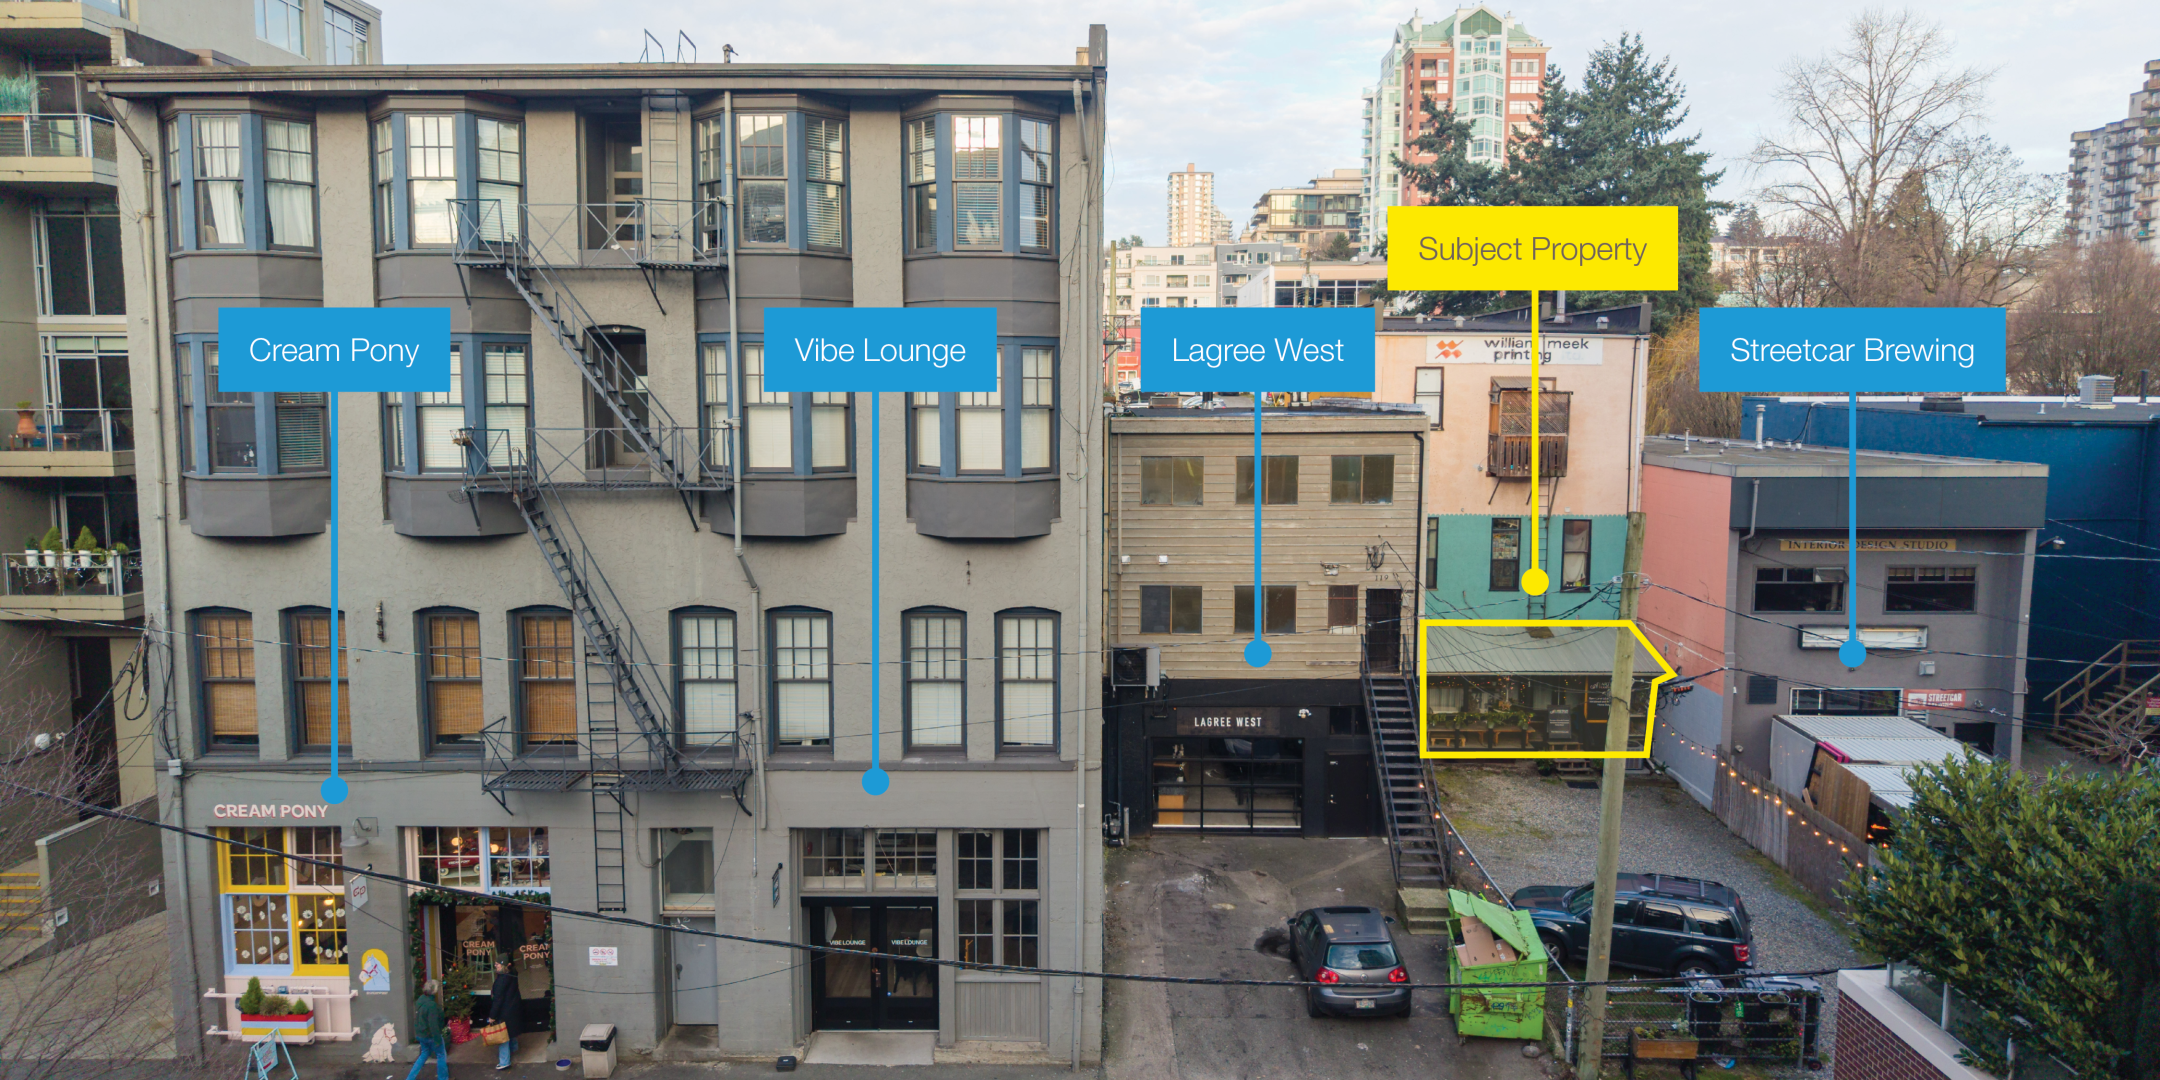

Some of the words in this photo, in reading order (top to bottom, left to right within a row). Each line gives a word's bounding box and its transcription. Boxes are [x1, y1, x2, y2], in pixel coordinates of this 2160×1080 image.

[1547, 338, 1589, 349] meek
[1494, 349, 1552, 363] printng
[1788, 540, 1845, 549] INTERIOR
[1903, 540, 1948, 549] STUDIO
[1928, 693, 1962, 701] STREETCAR
[1194, 716, 1232, 727] LAGREE
[1235, 716, 1262, 727] WEST
[213, 804, 276, 818] CREAM
[280, 804, 329, 818] PONY
[462, 940, 495, 948] CREAM
[466, 948, 492, 956] PONY
[523, 951, 550, 960] PONY
